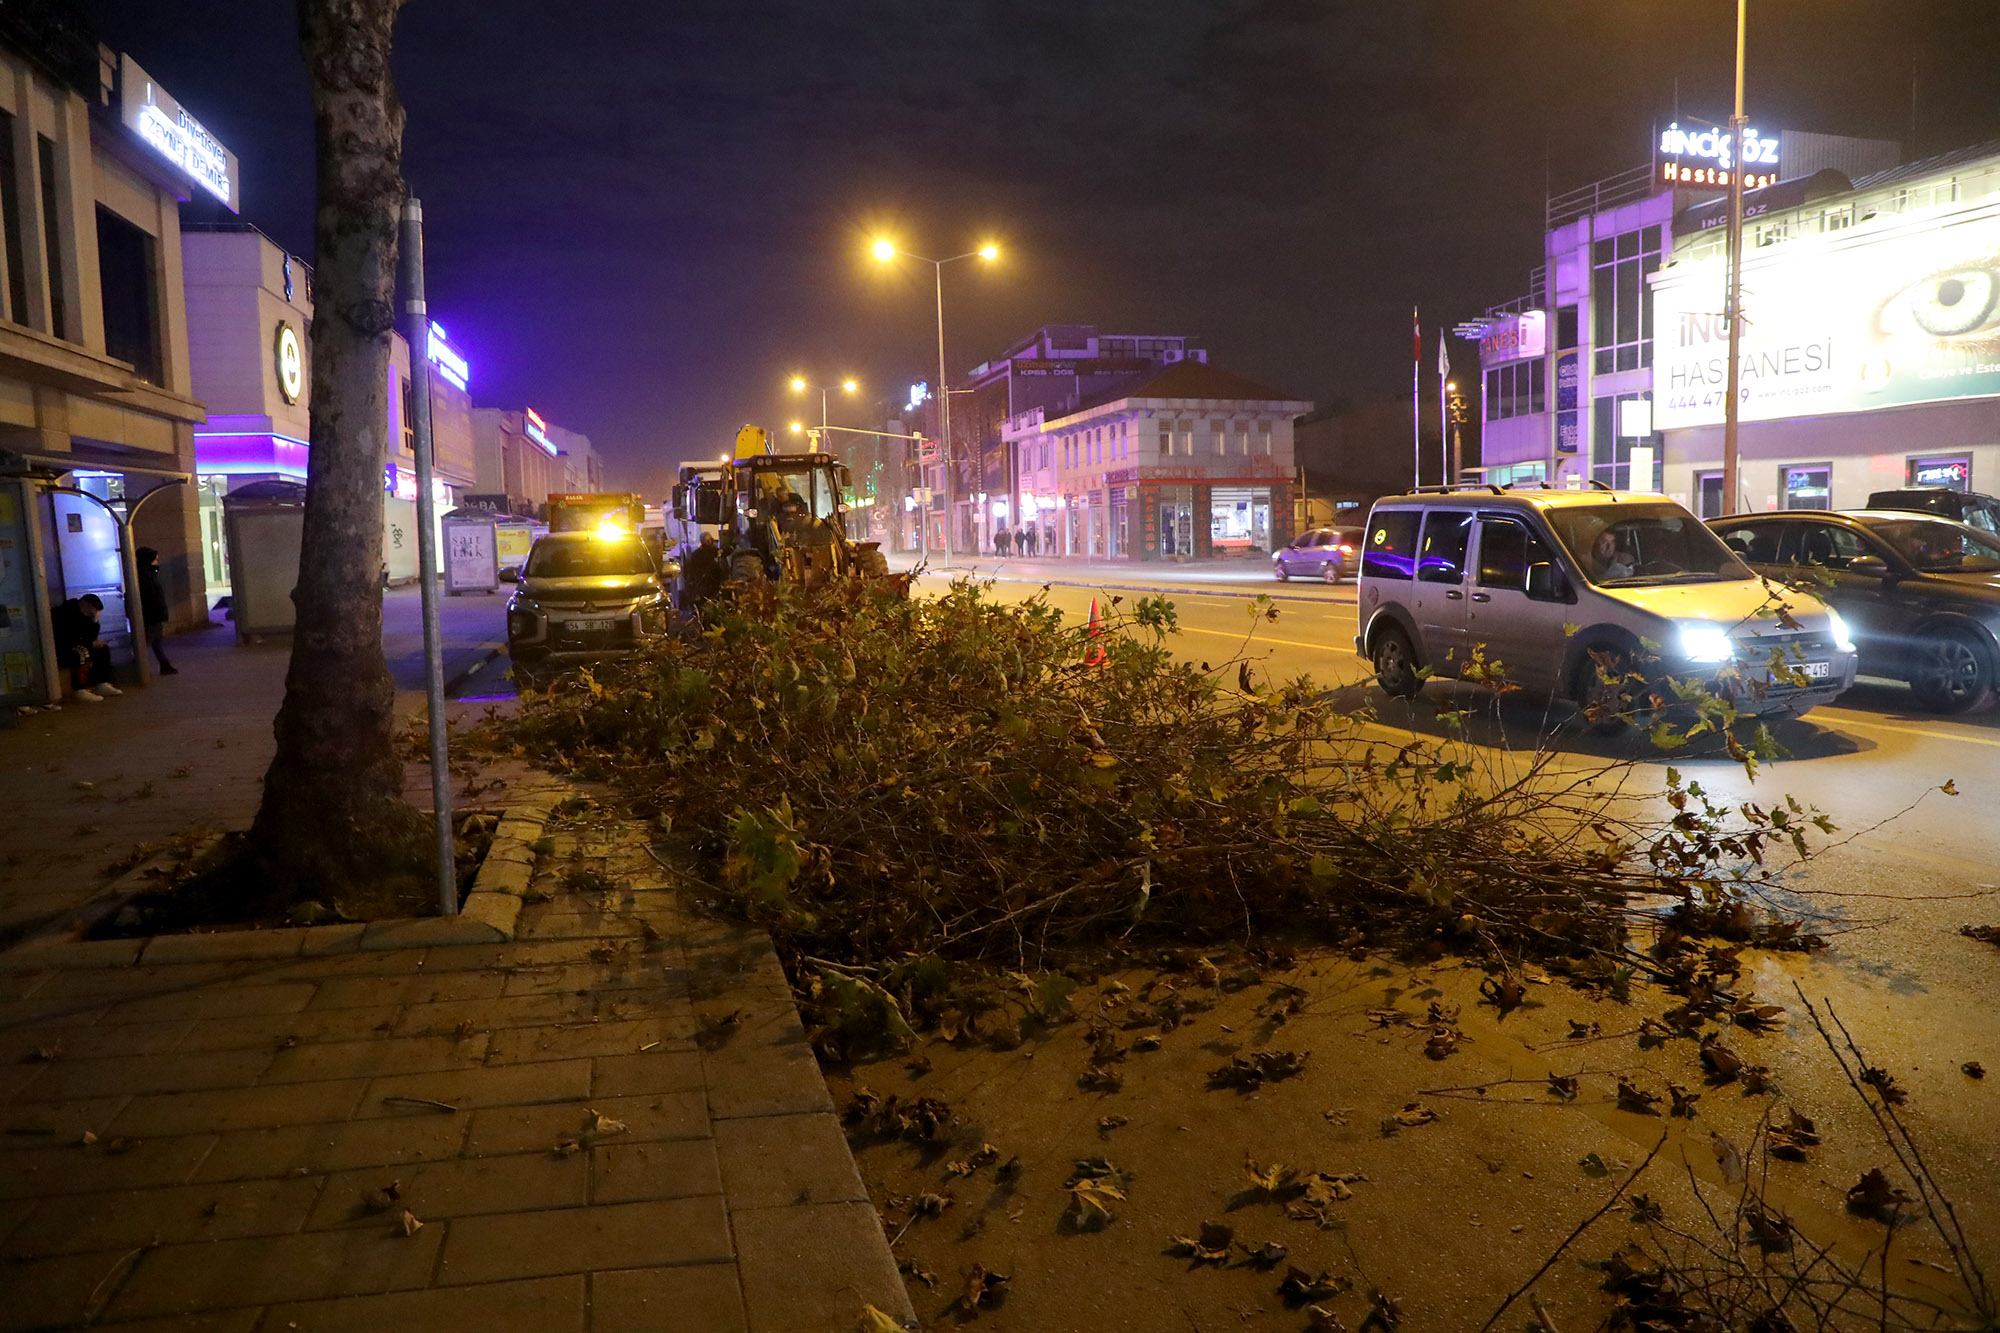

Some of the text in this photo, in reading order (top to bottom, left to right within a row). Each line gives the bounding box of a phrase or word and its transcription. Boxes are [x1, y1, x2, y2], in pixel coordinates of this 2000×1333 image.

[1664, 162, 1776, 188] Hastaesi
[1671, 336, 1832, 390] HASANESİ
[1669, 394, 1697, 409] 444
[1703, 388, 1750, 406] 479
[1813, 663, 1828, 676] 413
